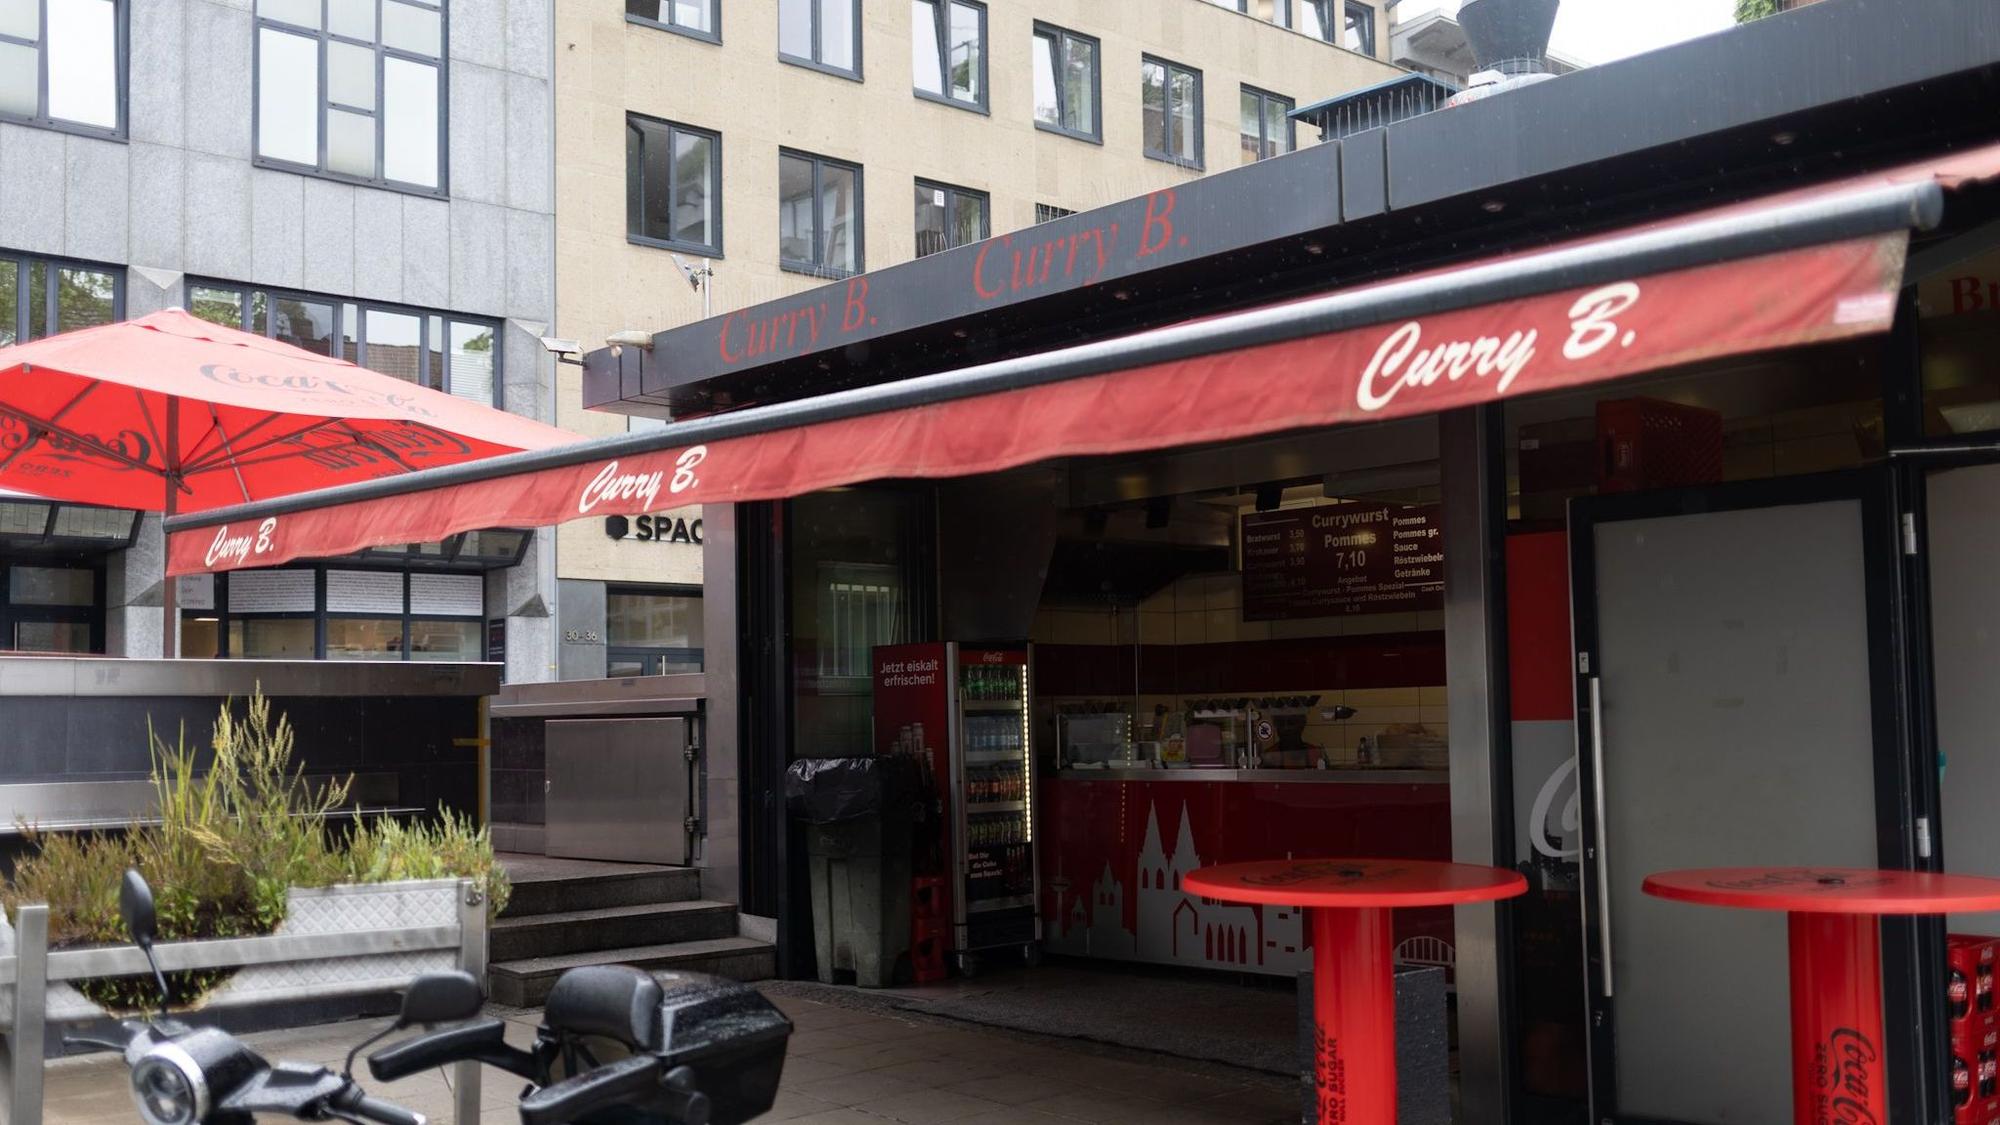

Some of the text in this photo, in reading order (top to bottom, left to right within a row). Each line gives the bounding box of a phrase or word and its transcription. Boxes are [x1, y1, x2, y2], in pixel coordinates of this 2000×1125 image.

[973, 188, 1189, 300] Curry B.
[719, 277, 879, 364] Curry B.
[1357, 281, 1640, 410] Curry B.
[578, 445, 708, 514] Curry B.
[1312, 507, 1389, 528] Currywurst
[1393, 516, 1426, 527] Pommes
[205, 517, 277, 568] Curry B.
[1324, 533, 1377, 548] Pommes
[1393, 530, 1427, 540] Pommes
[1394, 543, 1418, 552] Sauce
[1336, 550, 1366, 571] 7,10
[880, 658, 939, 674] Jetzt eiskalt
[884, 673, 936, 688] erfrischen!
[1328, 1038, 1339, 1093] SUGAR
